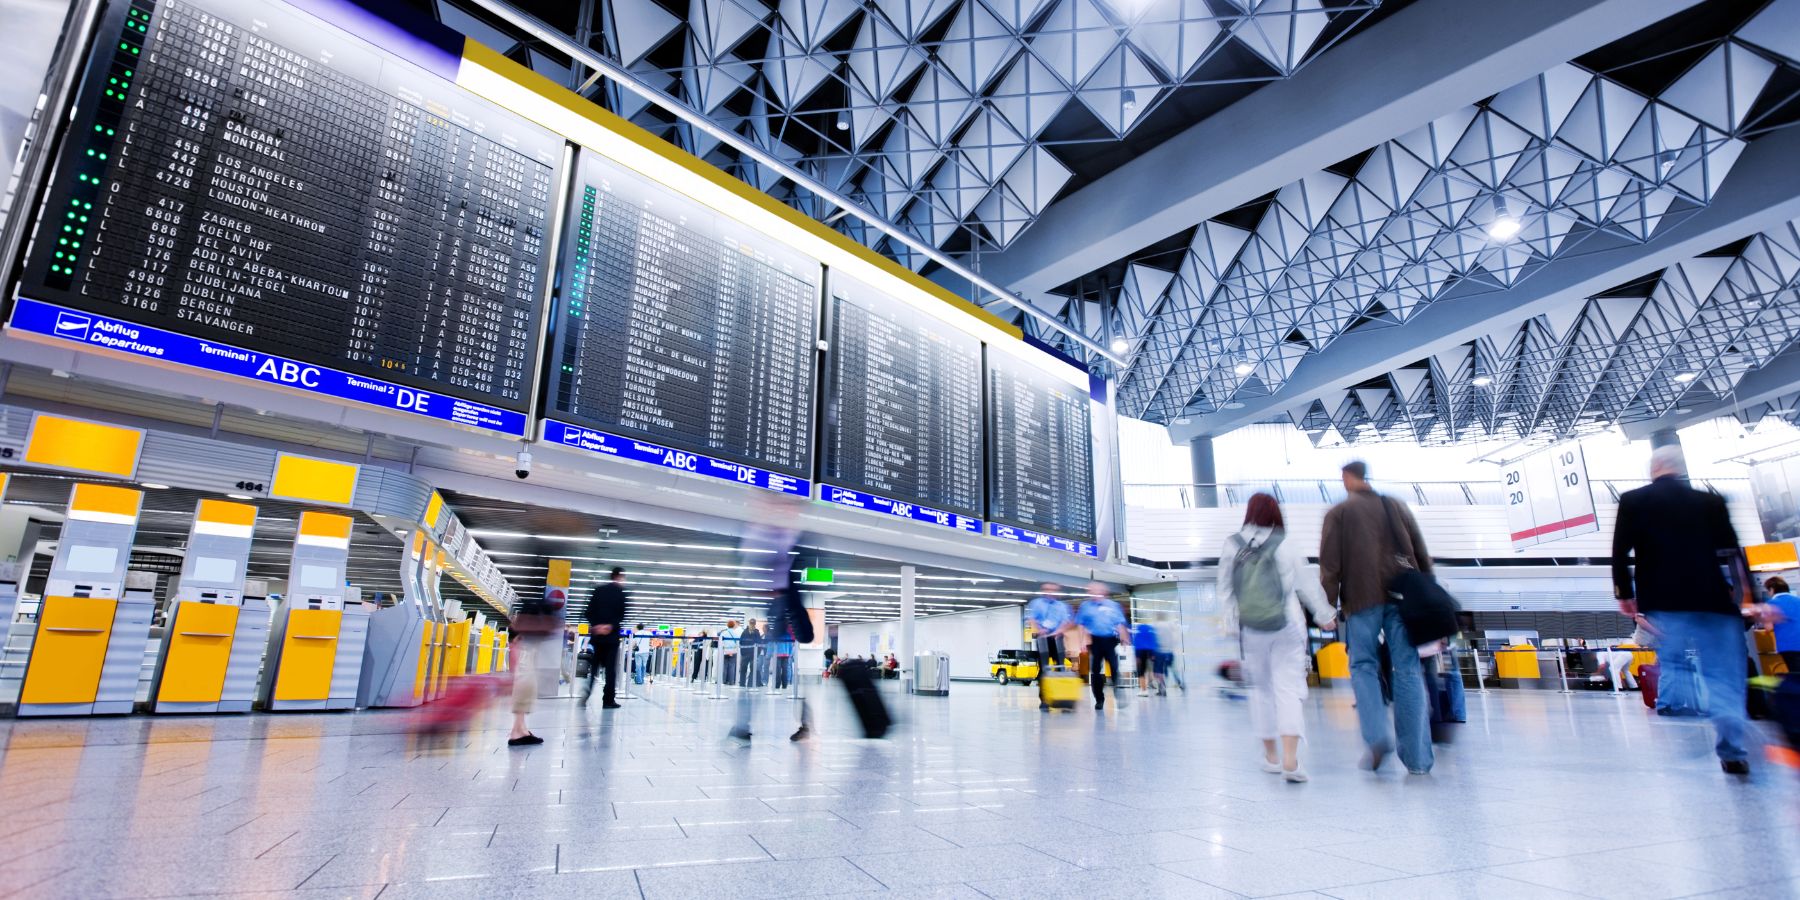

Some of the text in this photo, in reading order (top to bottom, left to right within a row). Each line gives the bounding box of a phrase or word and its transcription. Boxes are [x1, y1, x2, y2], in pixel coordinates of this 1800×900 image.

[158, 19, 168, 30] L
[202, 38, 227, 56] 468
[242, 56, 303, 88] PORTLAND
[162, 8, 171, 19] L
[196, 24, 230, 45] 3102
[245, 45, 305, 78] HELSINKI
[247, 35, 308, 68] VARADERO
[149, 53, 158, 64] L
[155, 30, 164, 41] L
[199, 49, 224, 66] 462
[239, 66, 278, 89] MIAMI
[139, 87, 148, 98] L
[184, 104, 210, 121] 494
[225, 120, 281, 148] CALGARY
[135, 98, 145, 110] A
[181, 116, 207, 132] 875
[222, 131, 286, 162] MONTREAL
[125, 134, 135, 145] L
[171, 150, 198, 167] 442
[214, 165, 271, 192] DETROIT
[128, 122, 138, 133] L
[174, 138, 201, 155] 456
[217, 153, 242, 170] LOS
[249, 165, 303, 192] ANGELES
[121, 146, 131, 157] L
[168, 162, 195, 178] 440
[211, 176, 268, 203] HOUSTON
[118, 158, 128, 169] L
[208, 188, 325, 234] LONDON-HEATHROW
[107, 195, 117, 206] L
[146, 206, 182, 226] 6808
[199, 223, 242, 244] KOELN
[248, 238, 273, 253] HBF
[158, 197, 186, 214] 417
[202, 211, 252, 235] ZAGREB
[103, 207, 114, 218] L
[152, 222, 179, 238] 686
[196, 235, 222, 251] TEL
[230, 245, 263, 262] AVIV
[96, 232, 106, 244] L
[145, 246, 173, 262] 176
[190, 259, 288, 294] BERLIN-TEGEL
[100, 220, 110, 231] L
[148, 234, 176, 250] 590
[193, 247, 236, 267] ADDIS
[243, 261, 349, 300] ABEBA-KHARTOUM
[88, 258, 99, 270] L
[128, 269, 166, 287] 4980
[183, 283, 236, 305] DUBLIN
[92, 245, 103, 257] J
[141, 259, 170, 275] 117
[186, 271, 262, 300] LJUBLJANA
[84, 272, 95, 283] L
[125, 282, 163, 300] 3126
[180, 296, 233, 318] BERGEN
[635, 286, 668, 304] BUDAPEST
[636, 277, 669, 296] BUKAREST
[81, 285, 91, 296] L
[121, 295, 160, 313] 3160
[177, 308, 254, 336] STAVANGER
[633, 303, 662, 319] KOLKATA
[634, 294, 667, 312] NEW YORK
[94, 320, 139, 339] Abflug
[631, 320, 661, 336] CHICAGO
[632, 311, 658, 326] DALLAS
[90, 332, 164, 355] Departures
[630, 328, 660, 344] DETROIT
[629, 337, 651, 350] PARIS
[671, 351, 679, 359] DE
[200, 343, 320, 387] Terminal 1 ABC
[626, 364, 665, 381] NUERNBERG
[627, 355, 697, 382] MOSKAU-DOMODEDOVO
[624, 382, 655, 396] TORONTO
[625, 372, 656, 388] VILNIUS
[346, 376, 386, 393] Terminal
[396, 389, 430, 412] DE
[623, 390, 658, 406] HELSINKI
[621, 409, 673, 428] POZNAN/POSEN
[622, 400, 662, 416] AMSTERDAM
[620, 418, 647, 431] DUBLIN
[581, 440, 617, 454] Departures
[582, 431, 605, 443] Abflug
[634, 442, 660, 455] Terminal
[663, 451, 697, 470] ABC
[1559, 451, 1574, 466] 10
[710, 460, 733, 471] Terminal
[737, 466, 756, 484] DE
[1506, 470, 1520, 485] 20
[1564, 472, 1578, 487] 10
[1510, 491, 1524, 505] 20
[892, 502, 912, 518] ABC
[937, 512, 949, 525] DE
[1036, 534, 1050, 546] ABC
